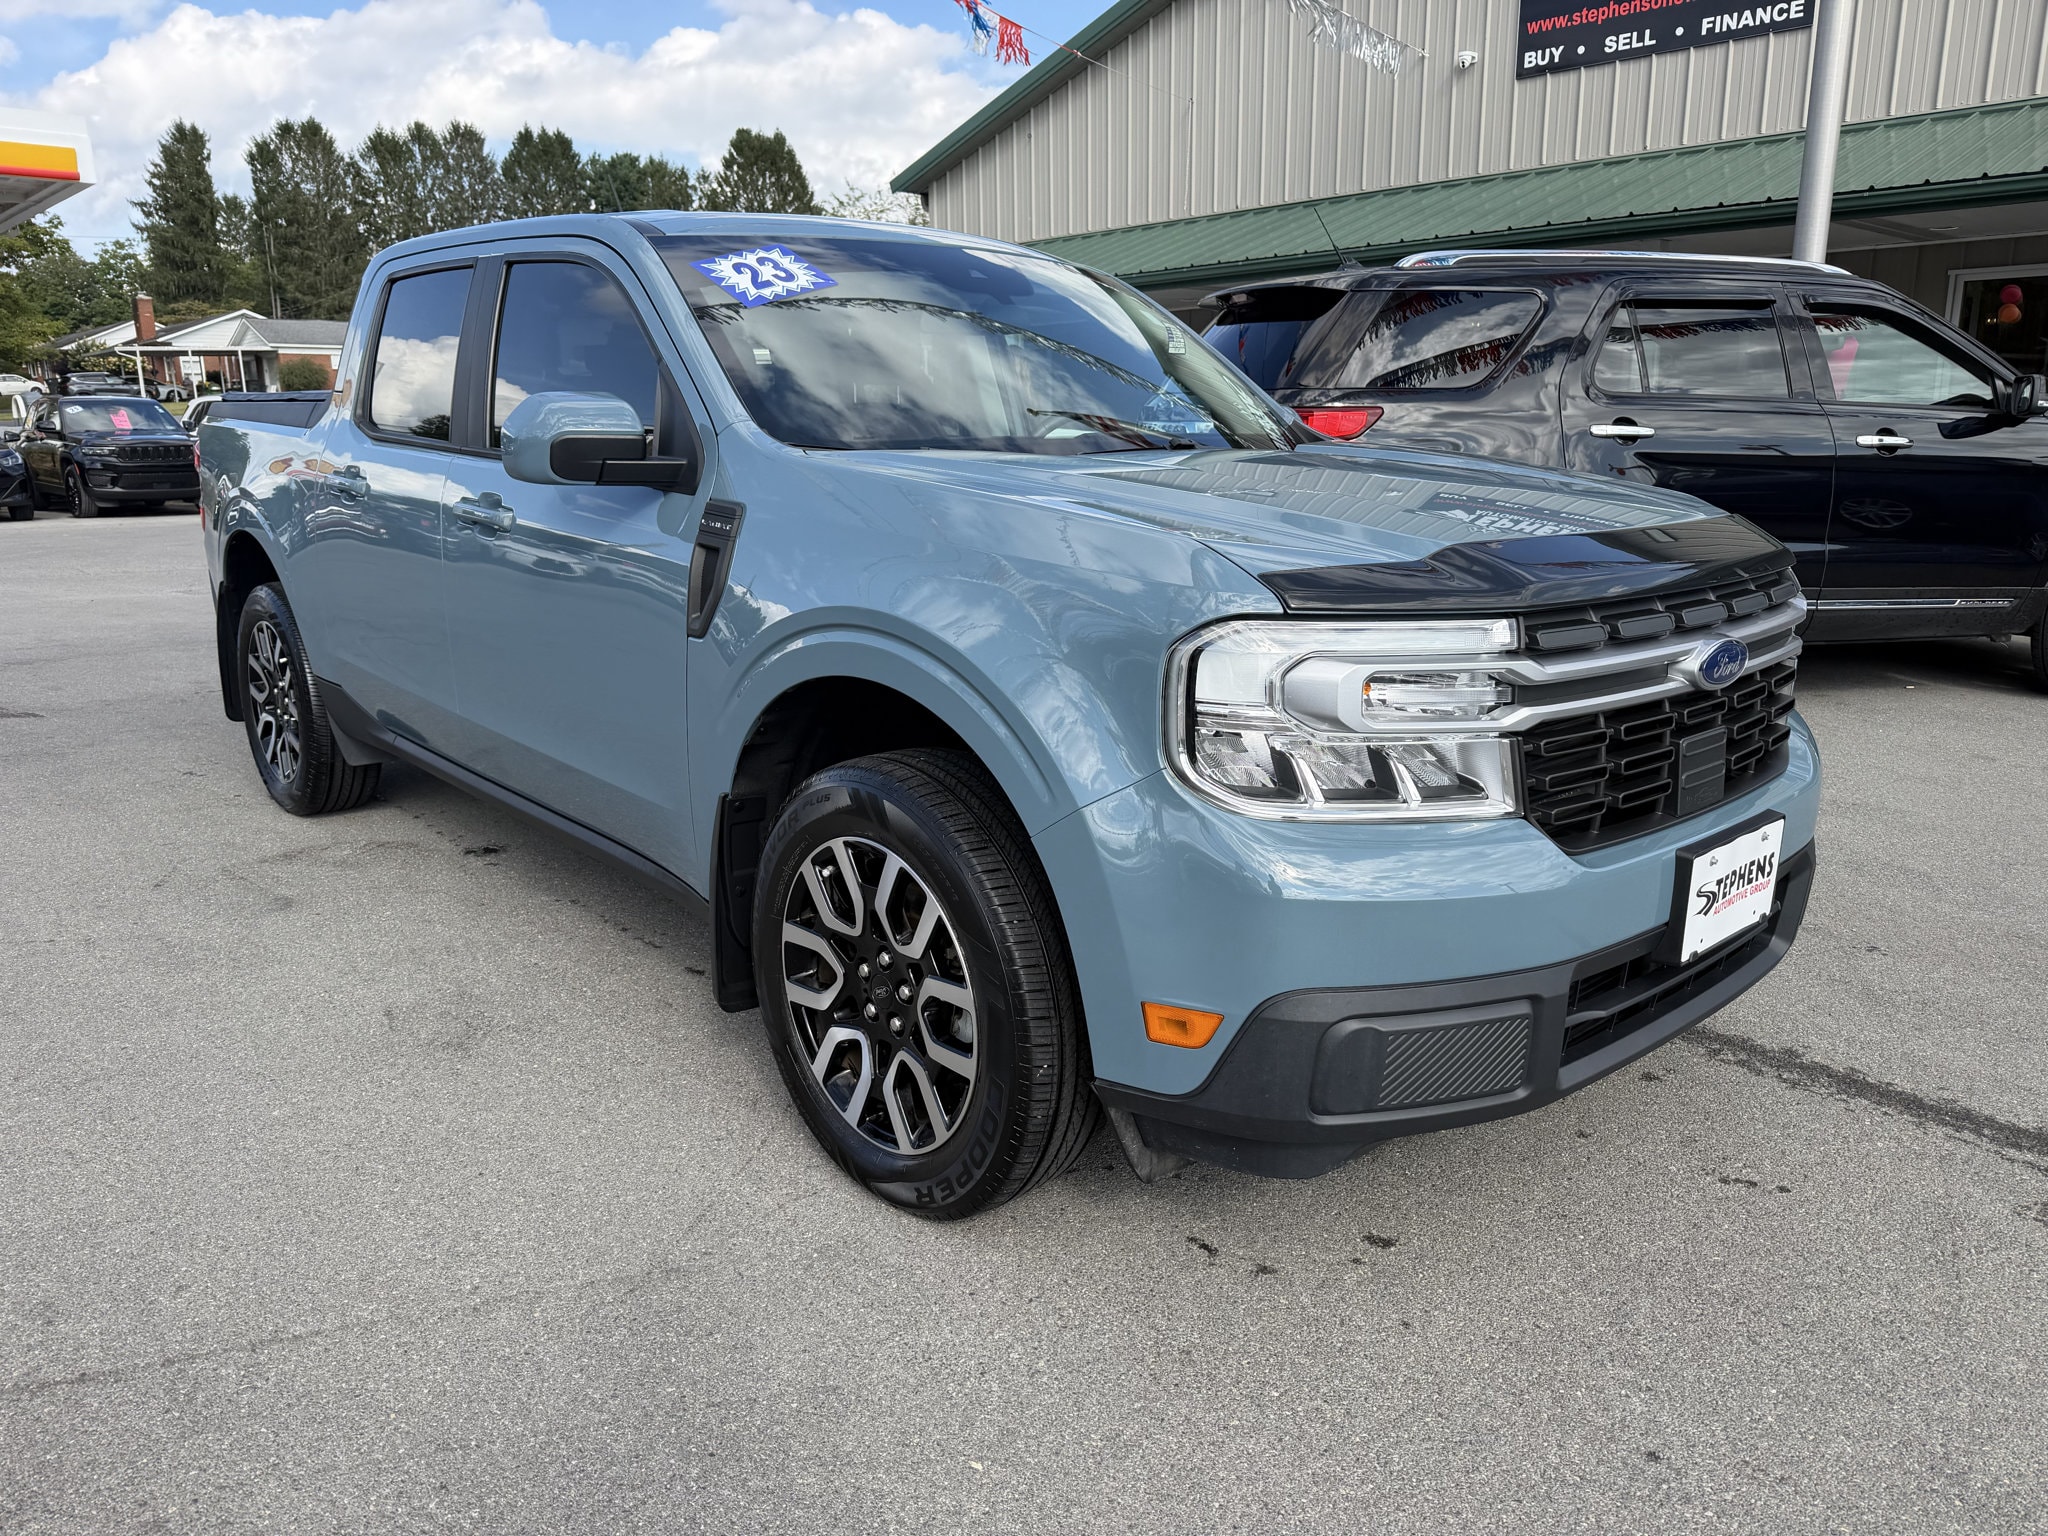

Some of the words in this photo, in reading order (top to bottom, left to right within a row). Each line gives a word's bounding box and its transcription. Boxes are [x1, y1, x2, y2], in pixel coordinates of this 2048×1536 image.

[1523, 45, 1565, 69] BUY
[1603, 28, 1657, 53] SELL
[1701, 0, 1805, 36] FINANCE
[731, 256, 796, 290] 23
[1713, 649, 1740, 679] Ford
[1692, 851, 1775, 917] STEPHENS
[1713, 888, 1749, 916] AUTOMOTIVE
[1749, 878, 1771, 896] GROUP
